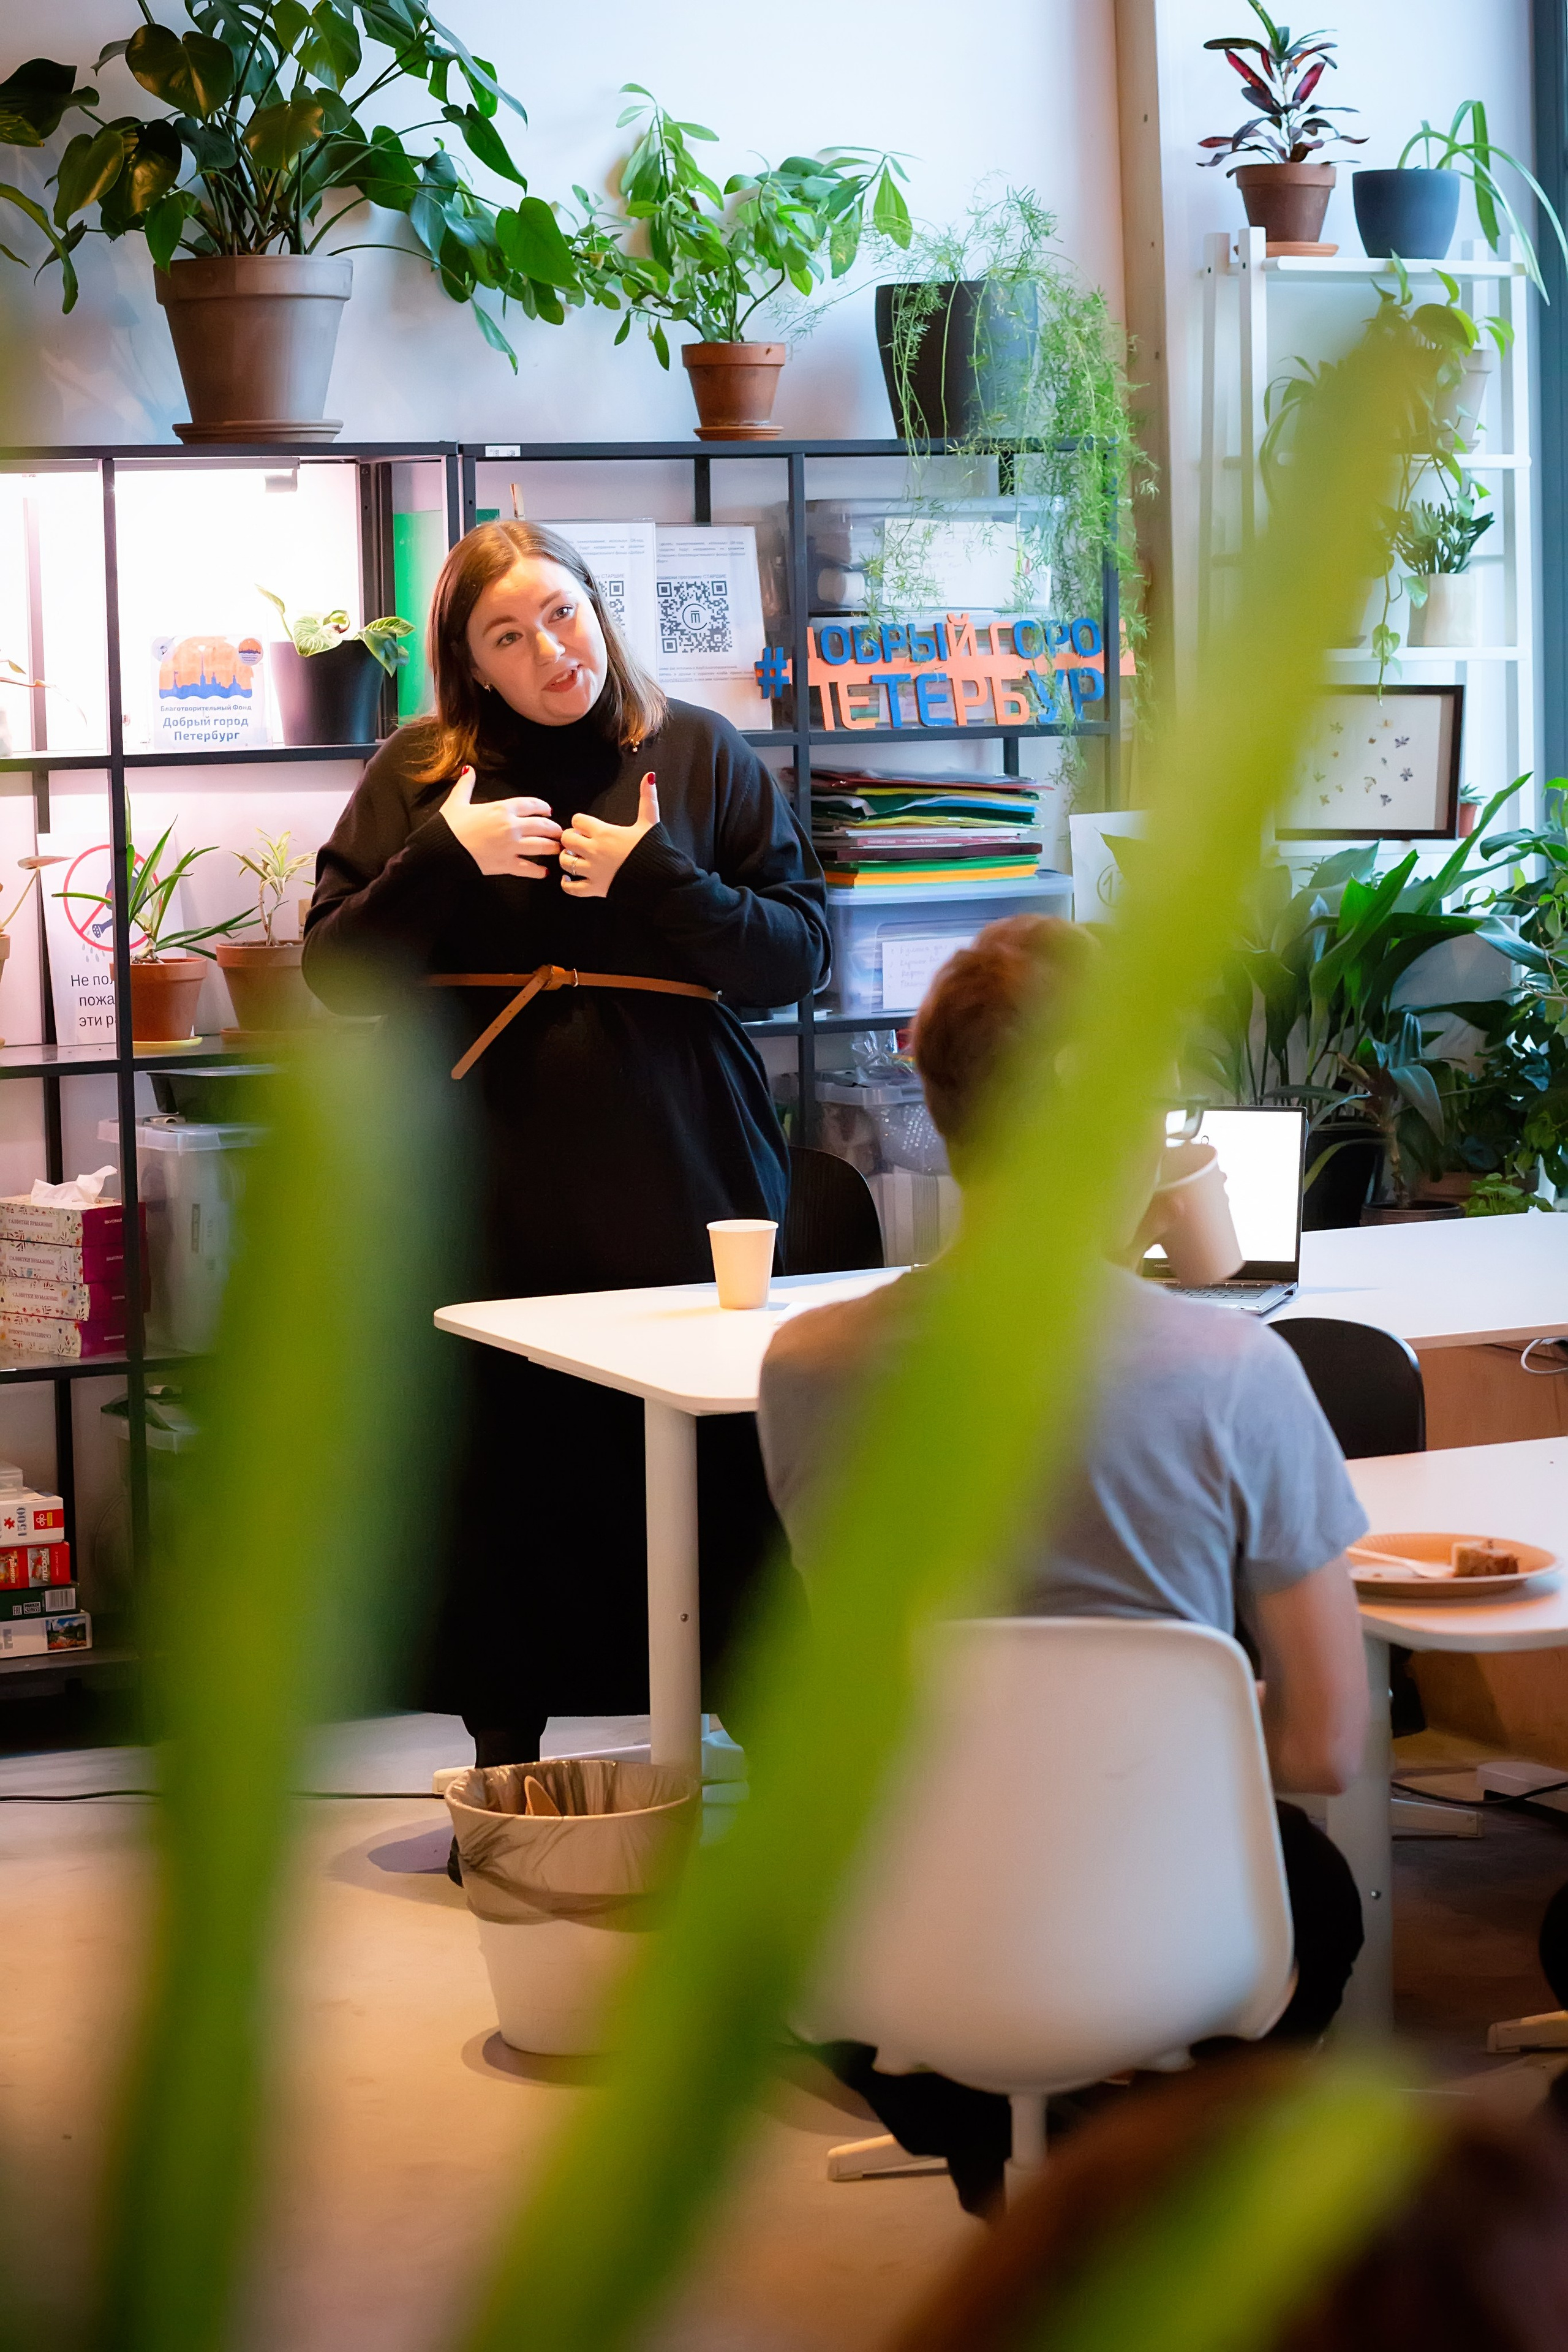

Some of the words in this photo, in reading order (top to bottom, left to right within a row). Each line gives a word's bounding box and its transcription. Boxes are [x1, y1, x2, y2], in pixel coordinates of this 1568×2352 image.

[162, 716, 211, 728] Добрый
[214, 718, 249, 728] город
[174, 730, 240, 742] Петербург
[70, 974, 89, 987] Не
[78, 1016, 102, 1027] эти
[16, 1507, 27, 1536] 1500
